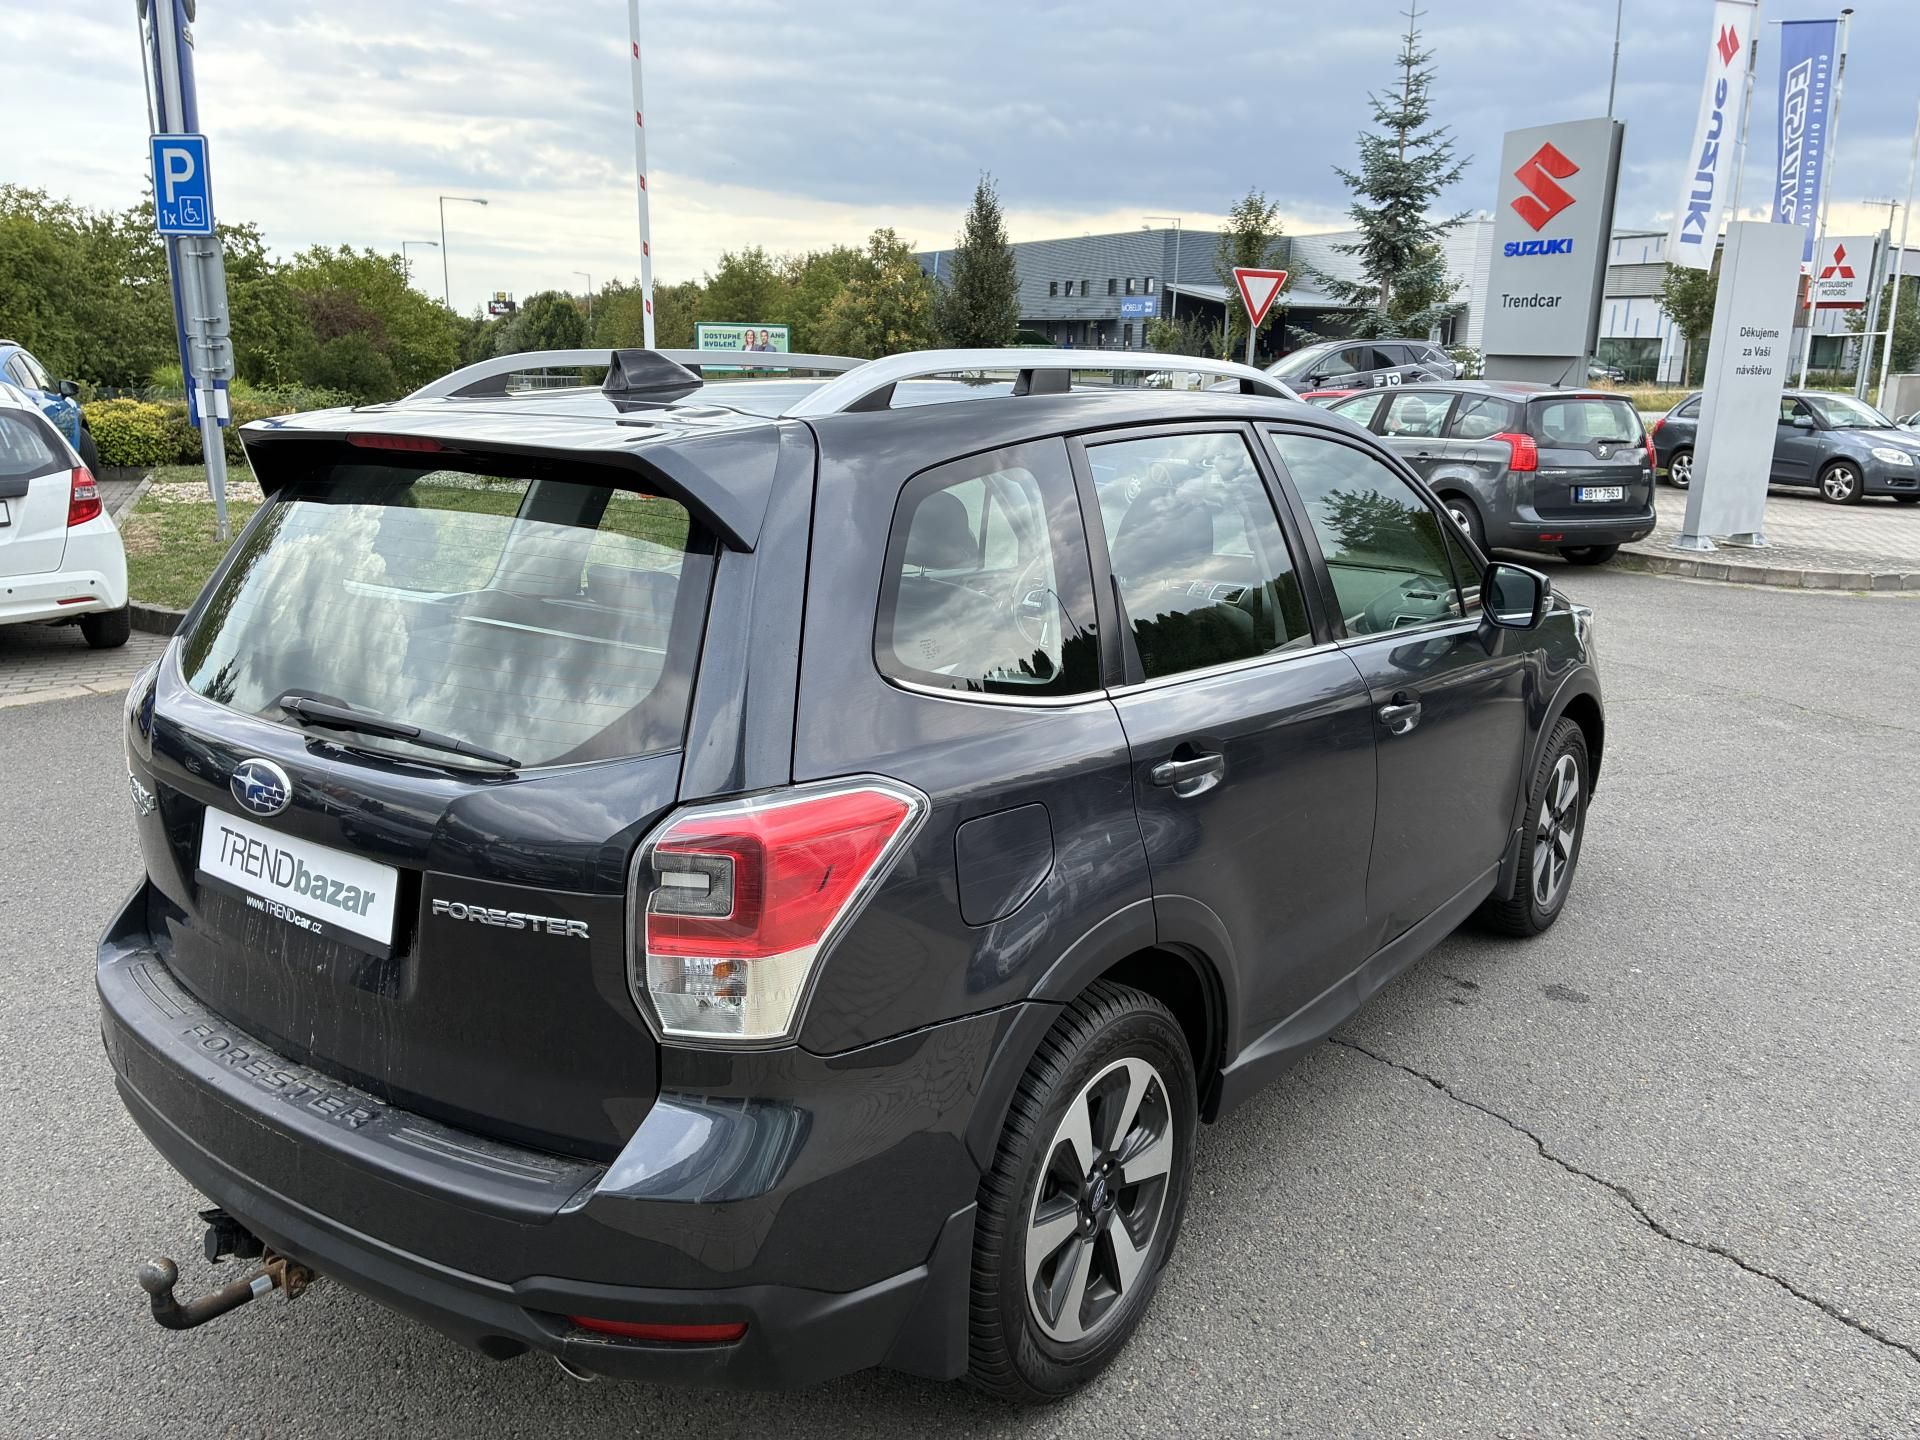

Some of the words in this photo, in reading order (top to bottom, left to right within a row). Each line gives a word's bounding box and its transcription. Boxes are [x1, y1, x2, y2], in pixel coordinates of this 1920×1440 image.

[162, 148, 195, 203] P
[163, 209, 177, 226] 1x
[1503, 238, 1573, 257] SUZUKI
[1502, 293, 1562, 308] Trendcar
[1822, 288, 1847, 296] MOTORS
[1740, 326, 1779, 340] Děkujeme
[1742, 348, 1752, 356] za
[1754, 346, 1771, 357] Vaši
[1736, 365, 1772, 376] návštěvu
[220, 826, 376, 917] TRENDbazar
[246, 895, 322, 935] www.TRENDcar.cz
[432, 898, 590, 939] FORESTER
[183, 1024, 379, 1129] FORESTER
